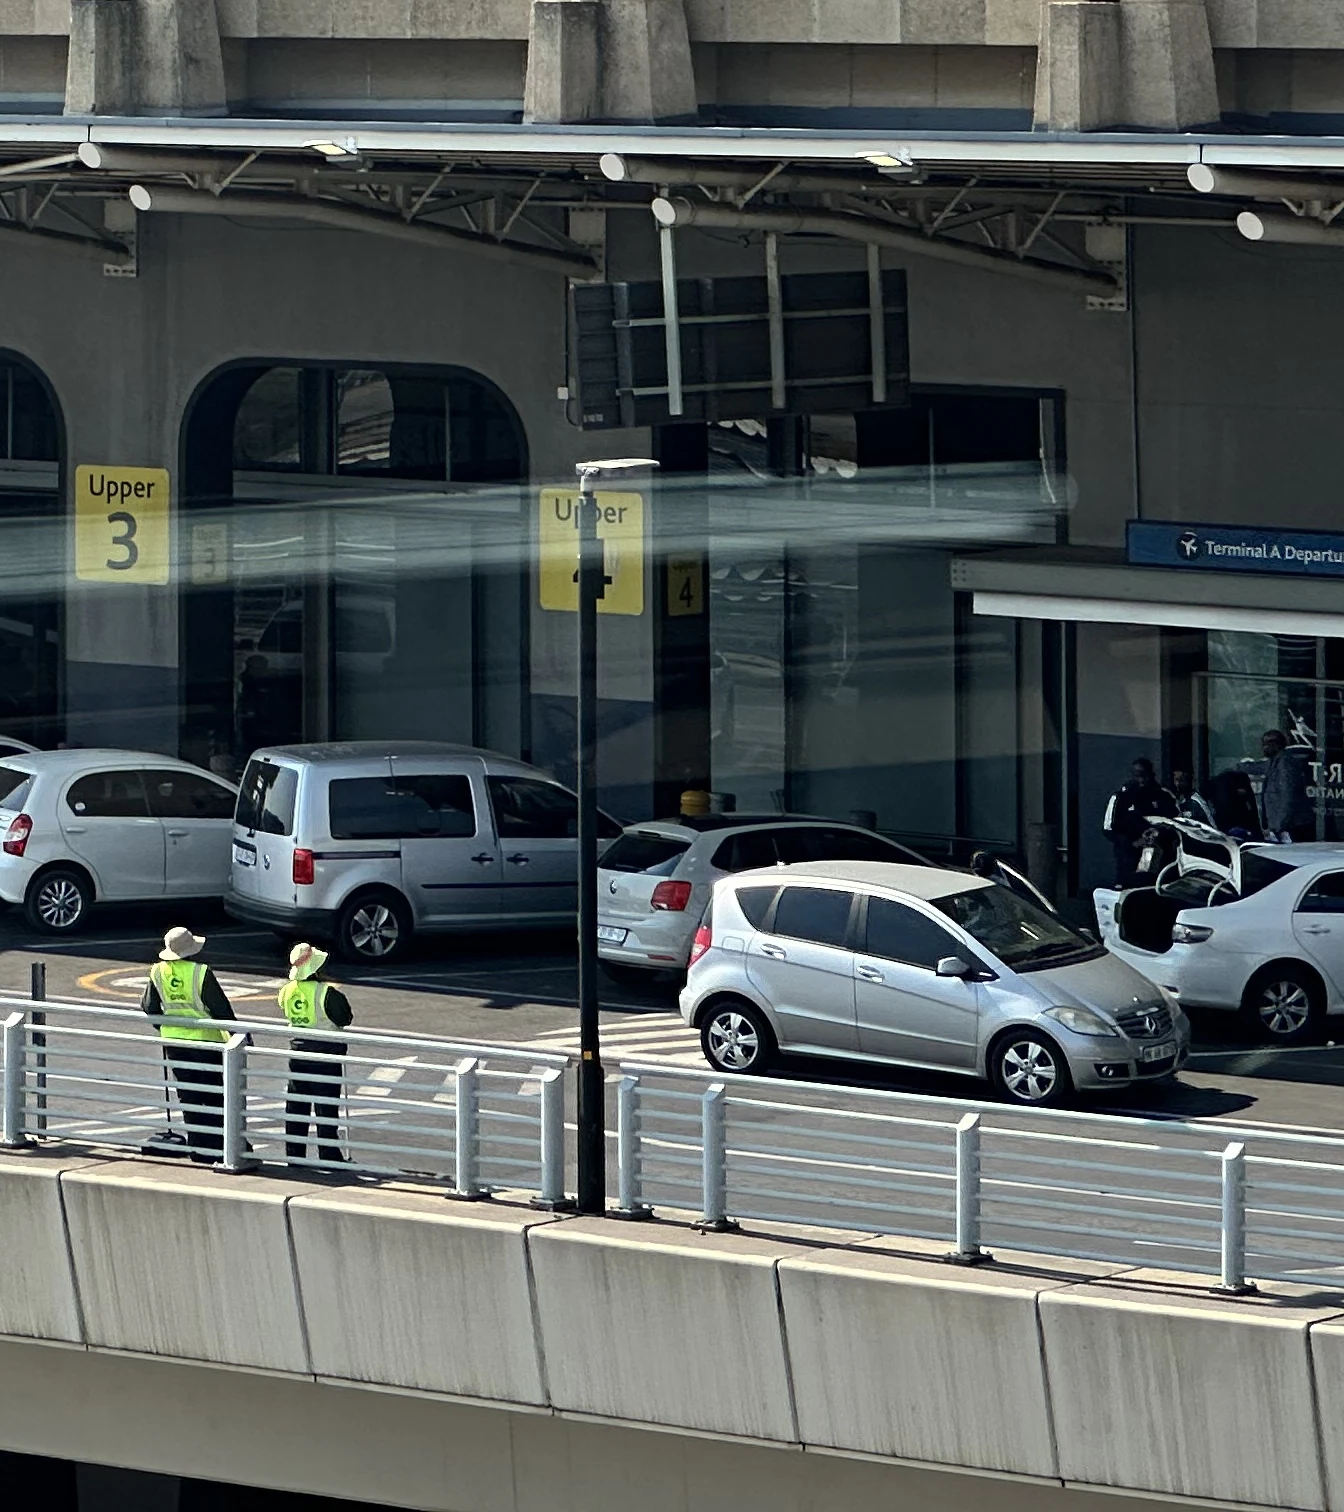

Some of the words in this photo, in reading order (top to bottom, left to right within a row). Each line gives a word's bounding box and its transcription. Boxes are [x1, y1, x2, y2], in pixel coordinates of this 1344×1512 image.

[89, 474, 155, 504] Upper
[106, 511, 139, 571] 3
[1205, 540, 1267, 558] Terminal
[1269, 546, 1282, 559] A
[679, 576, 693, 607] 4
